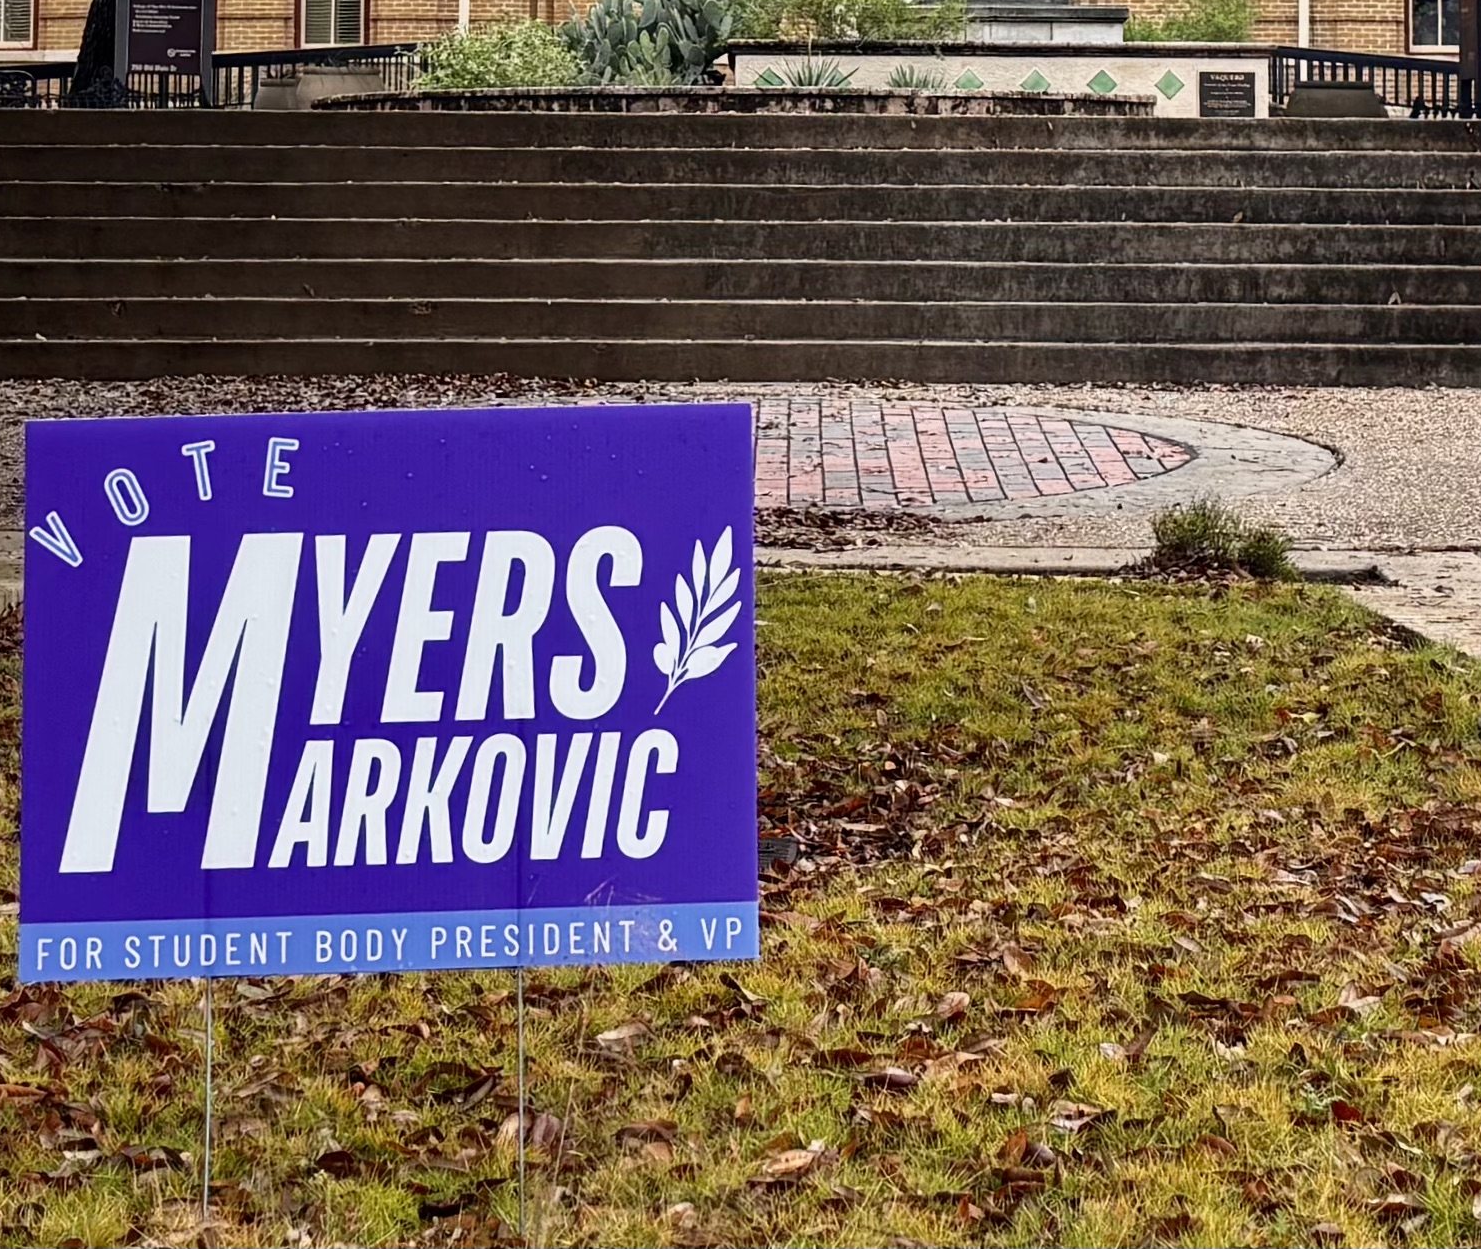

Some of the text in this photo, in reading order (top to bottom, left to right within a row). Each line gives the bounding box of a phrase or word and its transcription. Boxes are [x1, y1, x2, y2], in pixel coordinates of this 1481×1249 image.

[29, 437, 299, 567] VOTE
[59, 525, 643, 872] MYERS
[37, 917, 743, 971] FOR STUDENT BODY PRESIDENT & VP
